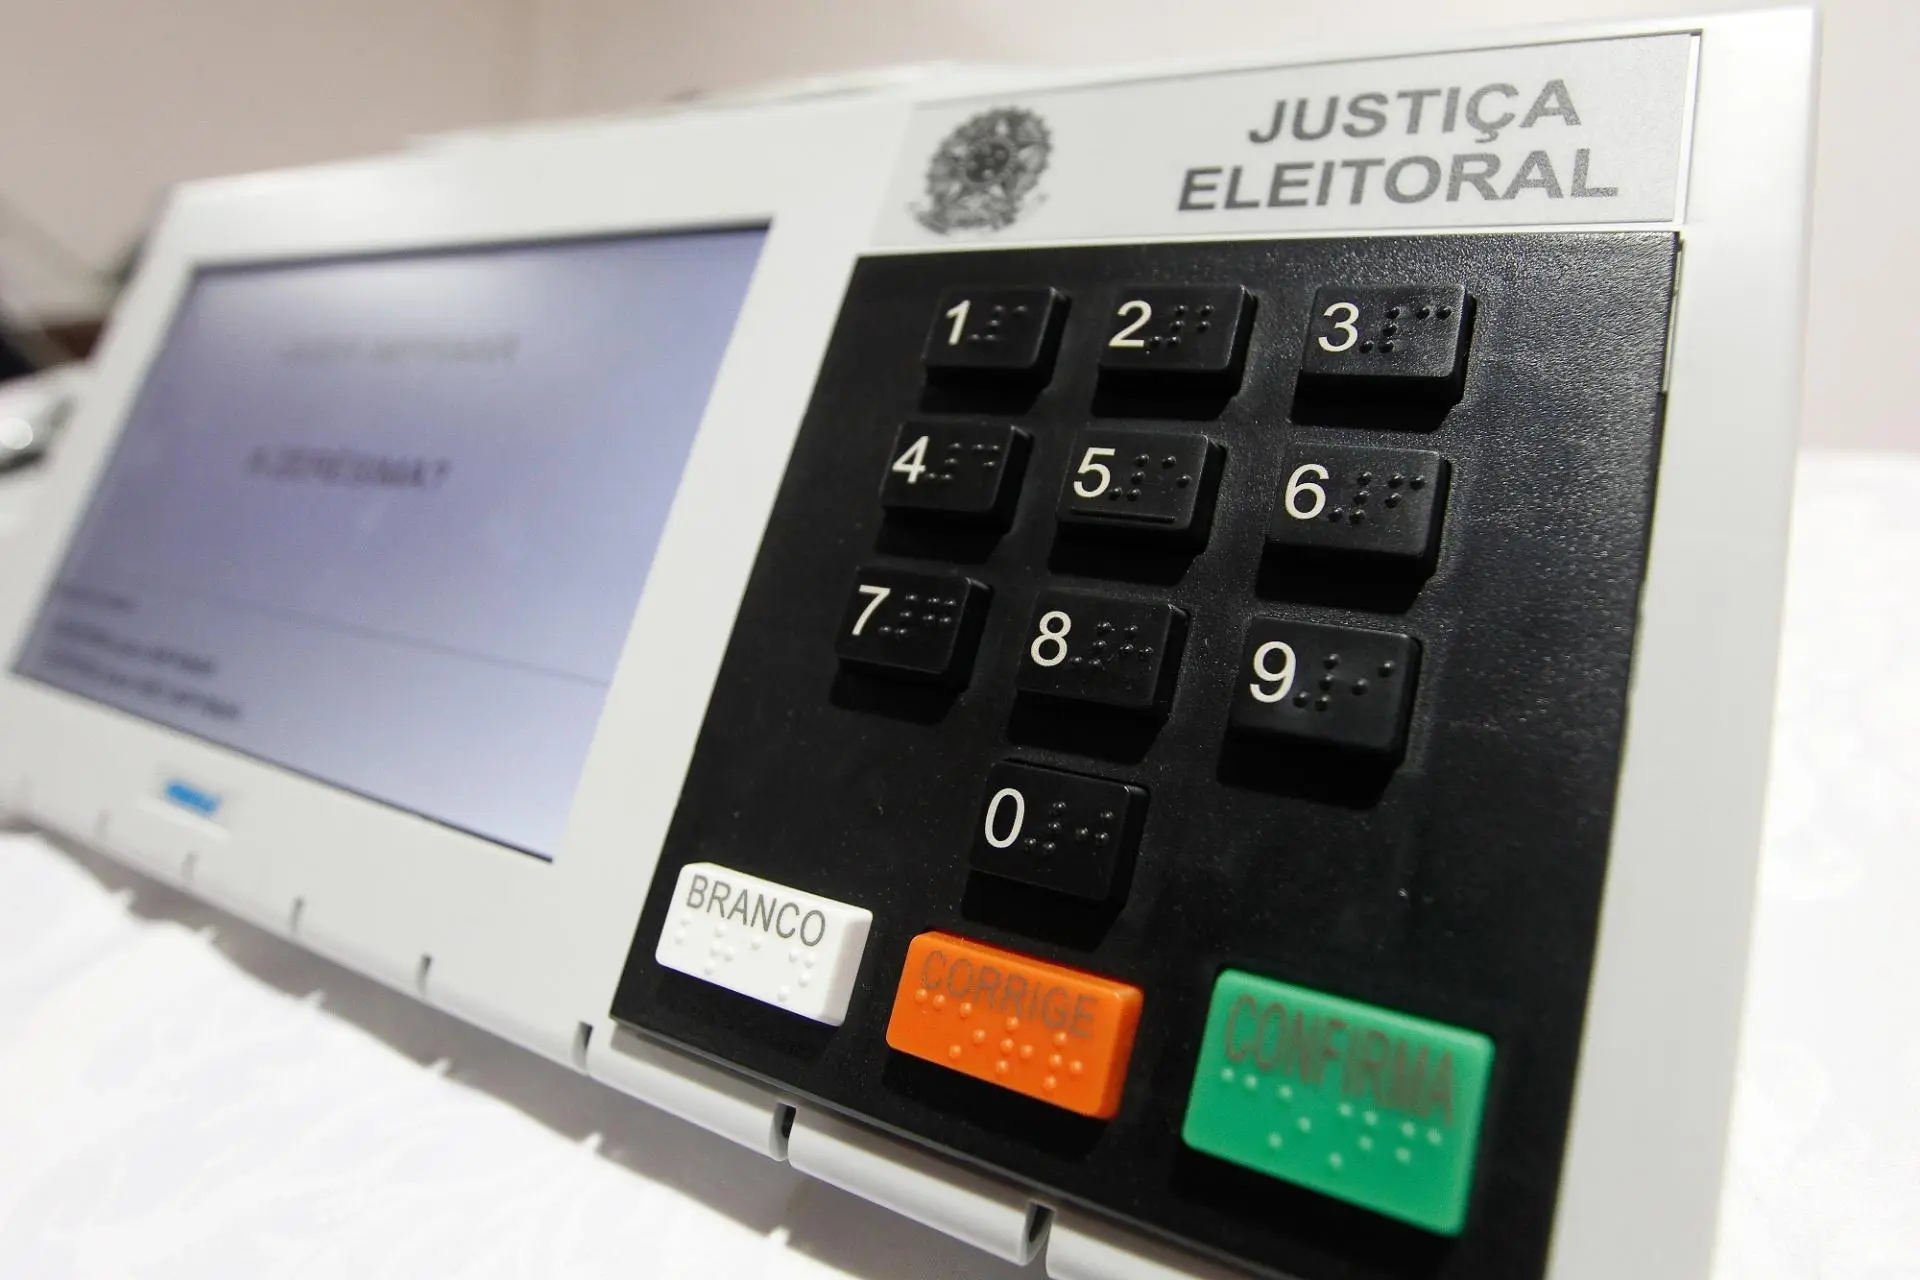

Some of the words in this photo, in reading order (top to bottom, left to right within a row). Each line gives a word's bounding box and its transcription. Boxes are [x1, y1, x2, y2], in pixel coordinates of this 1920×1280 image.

[1248, 79, 1582, 143] JUSTIÇA
[1177, 148, 1619, 211] ELEITORAL
[946, 299, 970, 345] 1
[1108, 299, 1152, 348] 2
[1317, 301, 1360, 353] 3
[892, 435, 929, 484] 4
[1073, 446, 1116, 498] 5
[1284, 463, 1330, 520] 6
[852, 584, 891, 636] 7
[1030, 610, 1072, 667] 8
[1249, 640, 1297, 703] 9
[984, 787, 1025, 849] 0
[686, 873, 826, 948] BRANCO
[919, 950, 1100, 1040] CORRIGE
[1222, 994, 1458, 1126] CONFIRMA
